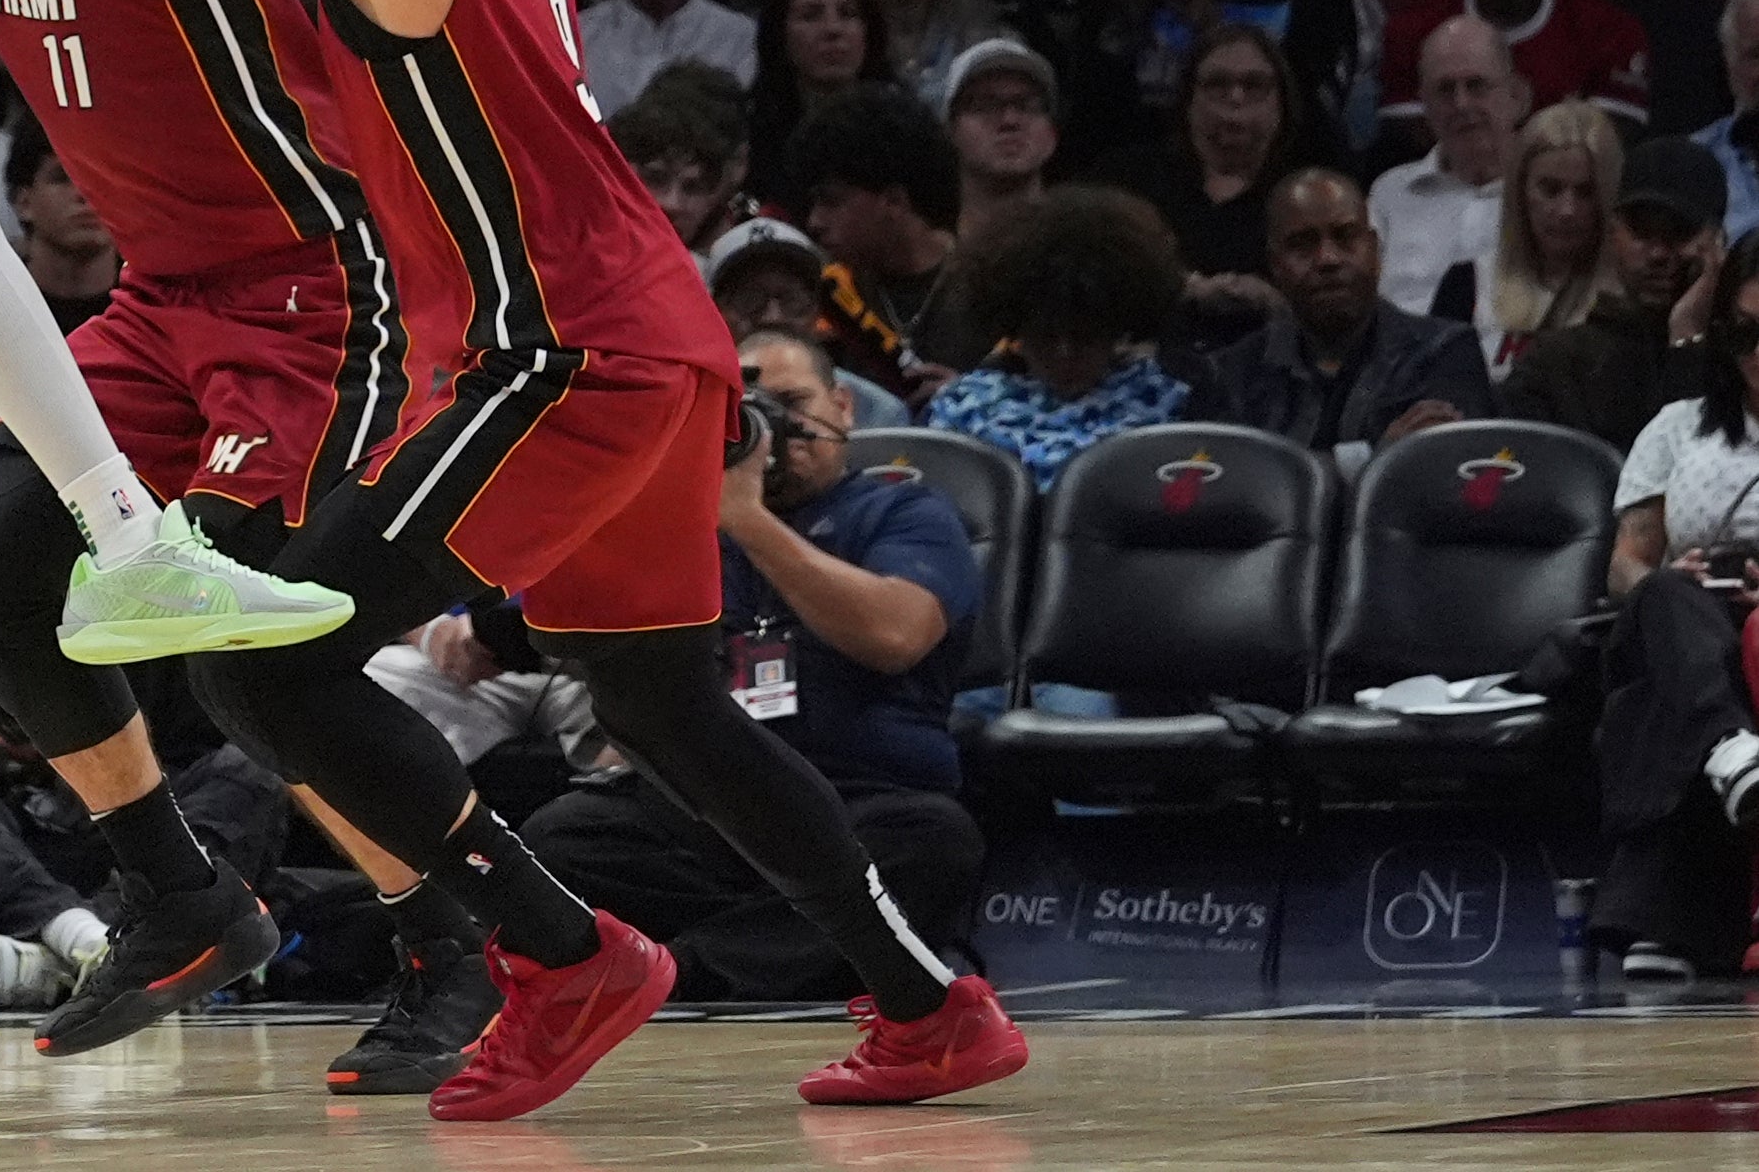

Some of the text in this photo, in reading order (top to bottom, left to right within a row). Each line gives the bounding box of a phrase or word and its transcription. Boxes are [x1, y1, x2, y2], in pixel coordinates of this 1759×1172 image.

[42, 34, 93, 109] 11
[985, 888, 1267, 935] ONE Sotheby's
[1384, 868, 1484, 940] ONE
